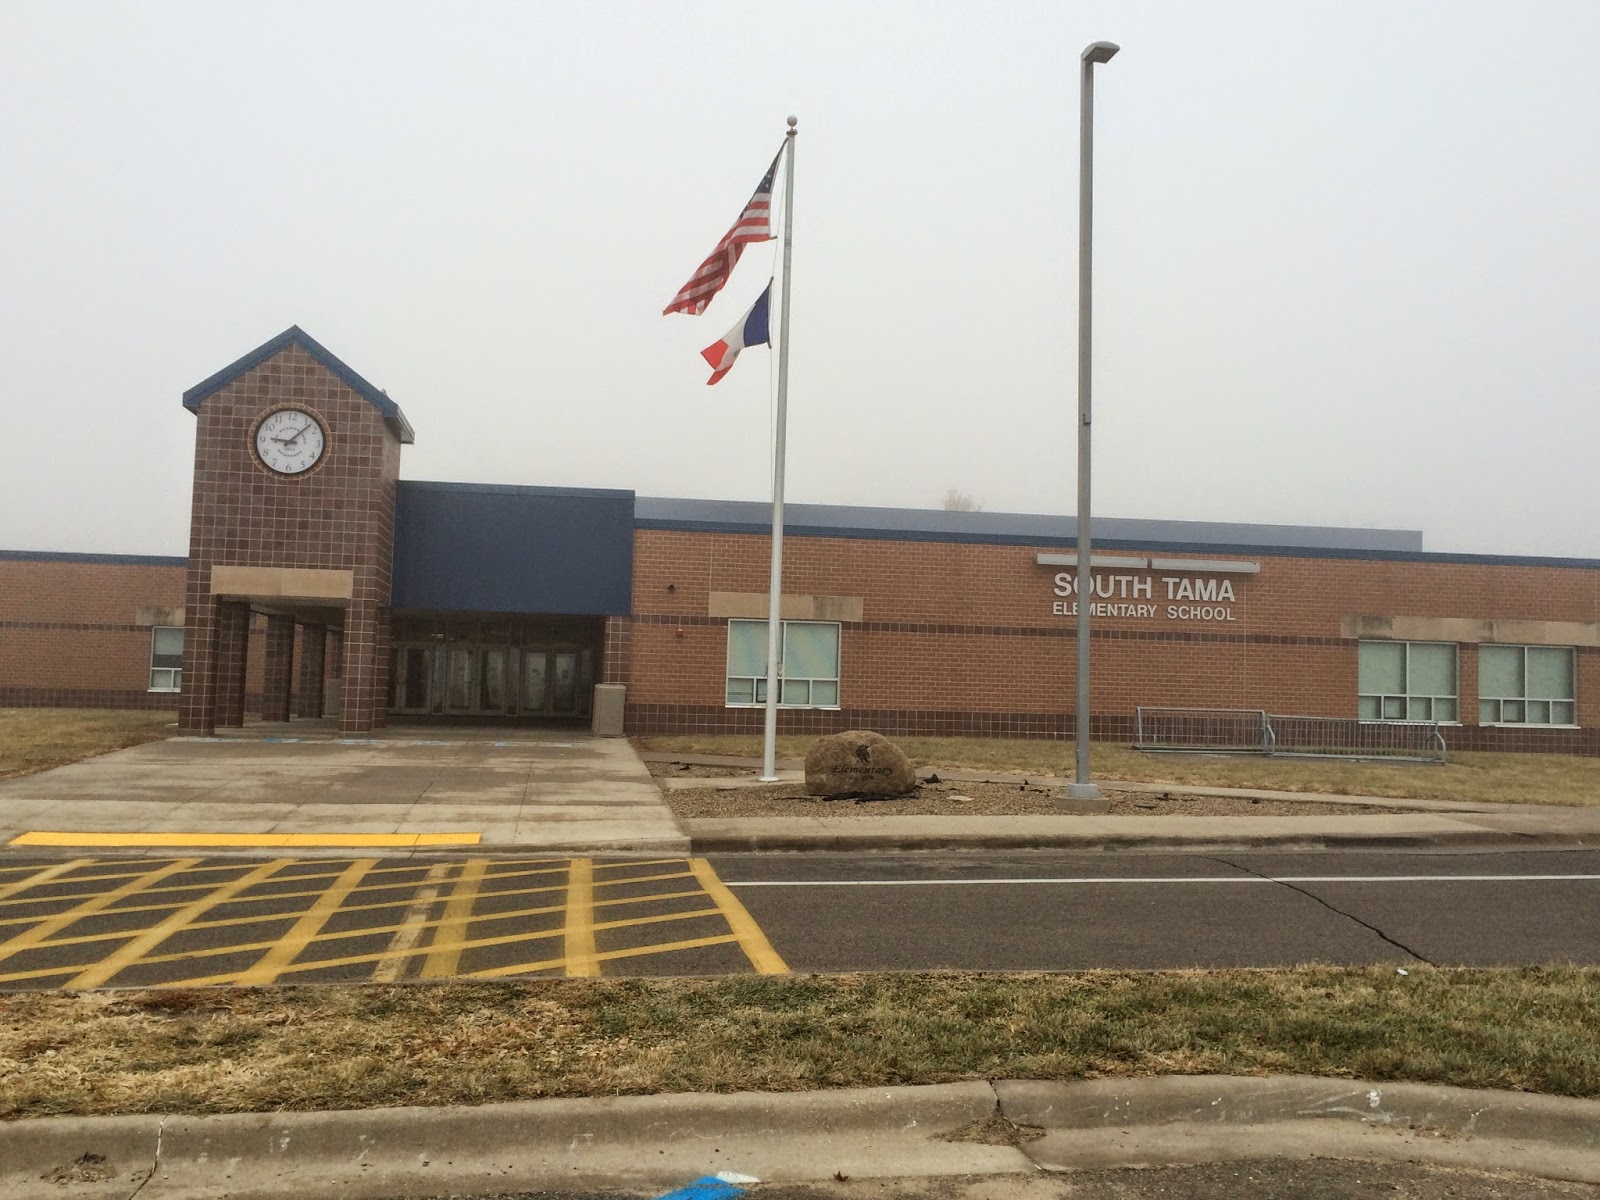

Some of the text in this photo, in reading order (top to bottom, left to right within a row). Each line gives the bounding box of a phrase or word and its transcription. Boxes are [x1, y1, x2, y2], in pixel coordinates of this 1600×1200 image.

[272, 458, 277, 466] 7
[1162, 577, 1236, 602] TAMA
[1167, 605, 1236, 621] SCHOOL
[832, 764, 893, 777] Elementary
